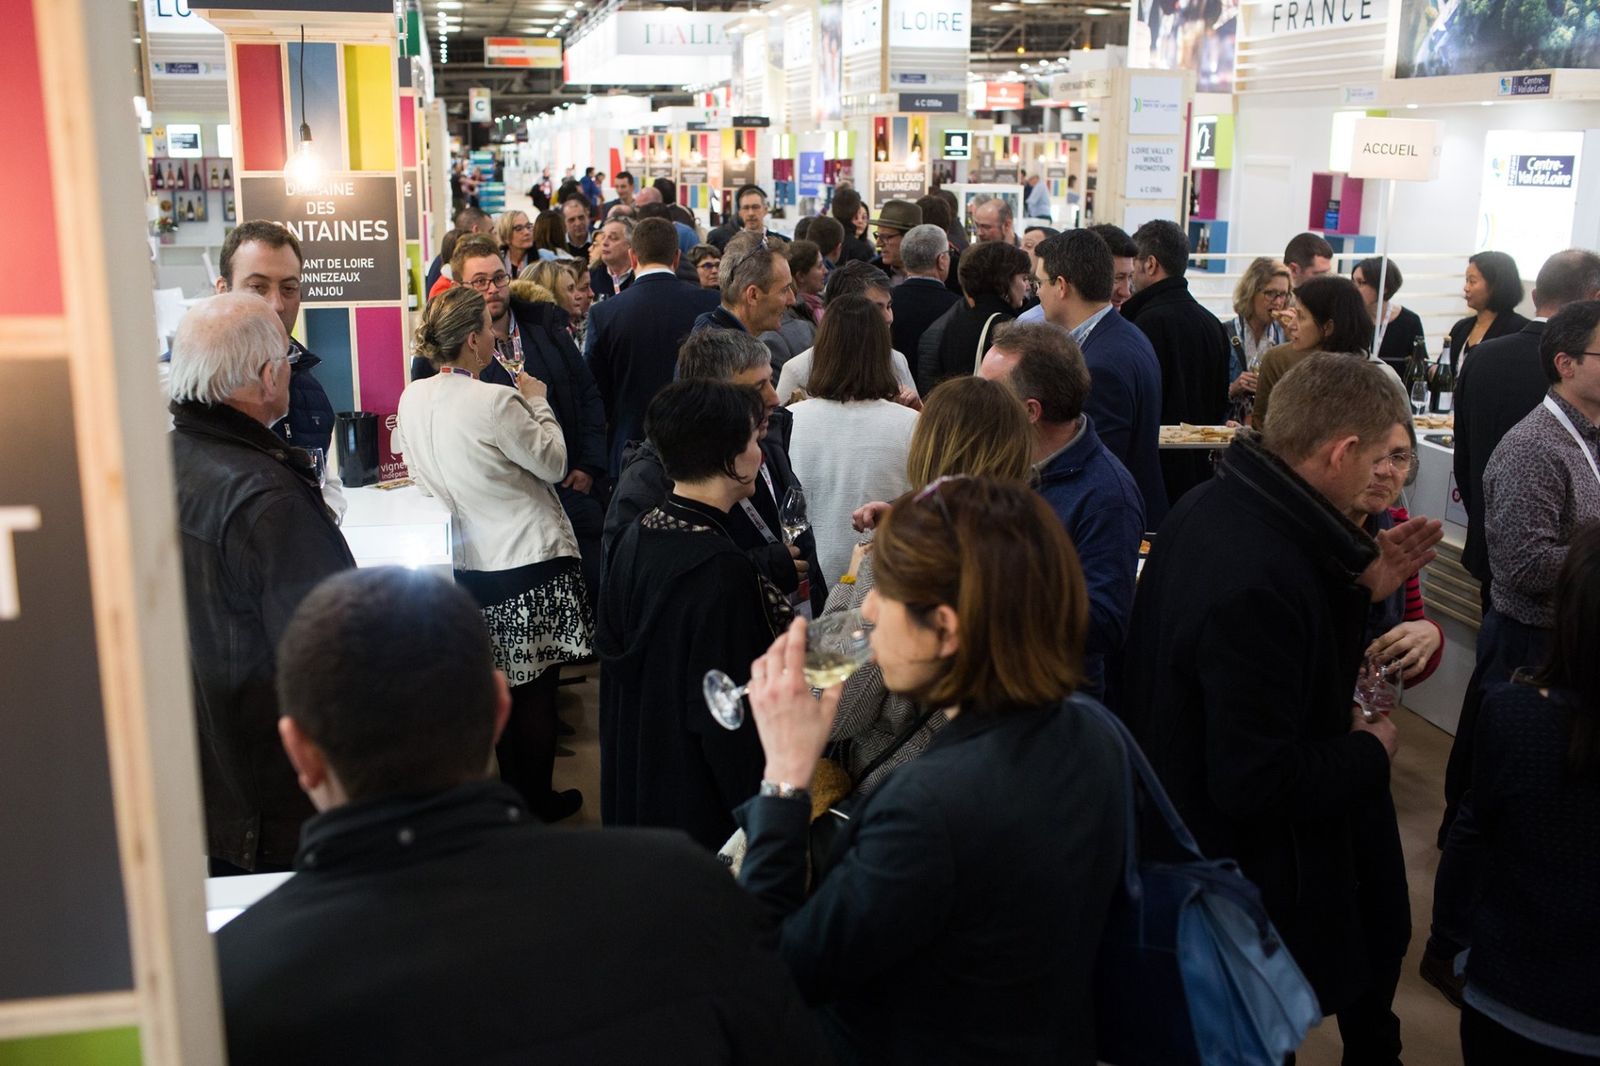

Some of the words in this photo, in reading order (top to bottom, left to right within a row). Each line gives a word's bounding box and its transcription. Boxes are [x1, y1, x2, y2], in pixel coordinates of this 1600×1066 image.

[902, 11, 963, 31] LOIRE
[1272, 0, 1371, 32] FRANCE
[1363, 142, 1419, 157] ACCUEIL
[1134, 164, 1170, 172] PROMOTION
[1526, 157, 1564, 171] Centre-
[306, 201, 336, 215] DES
[327, 258, 341, 269] DE
[343, 258, 375, 269] LOIRE
[308, 286, 343, 297] ANJOU
